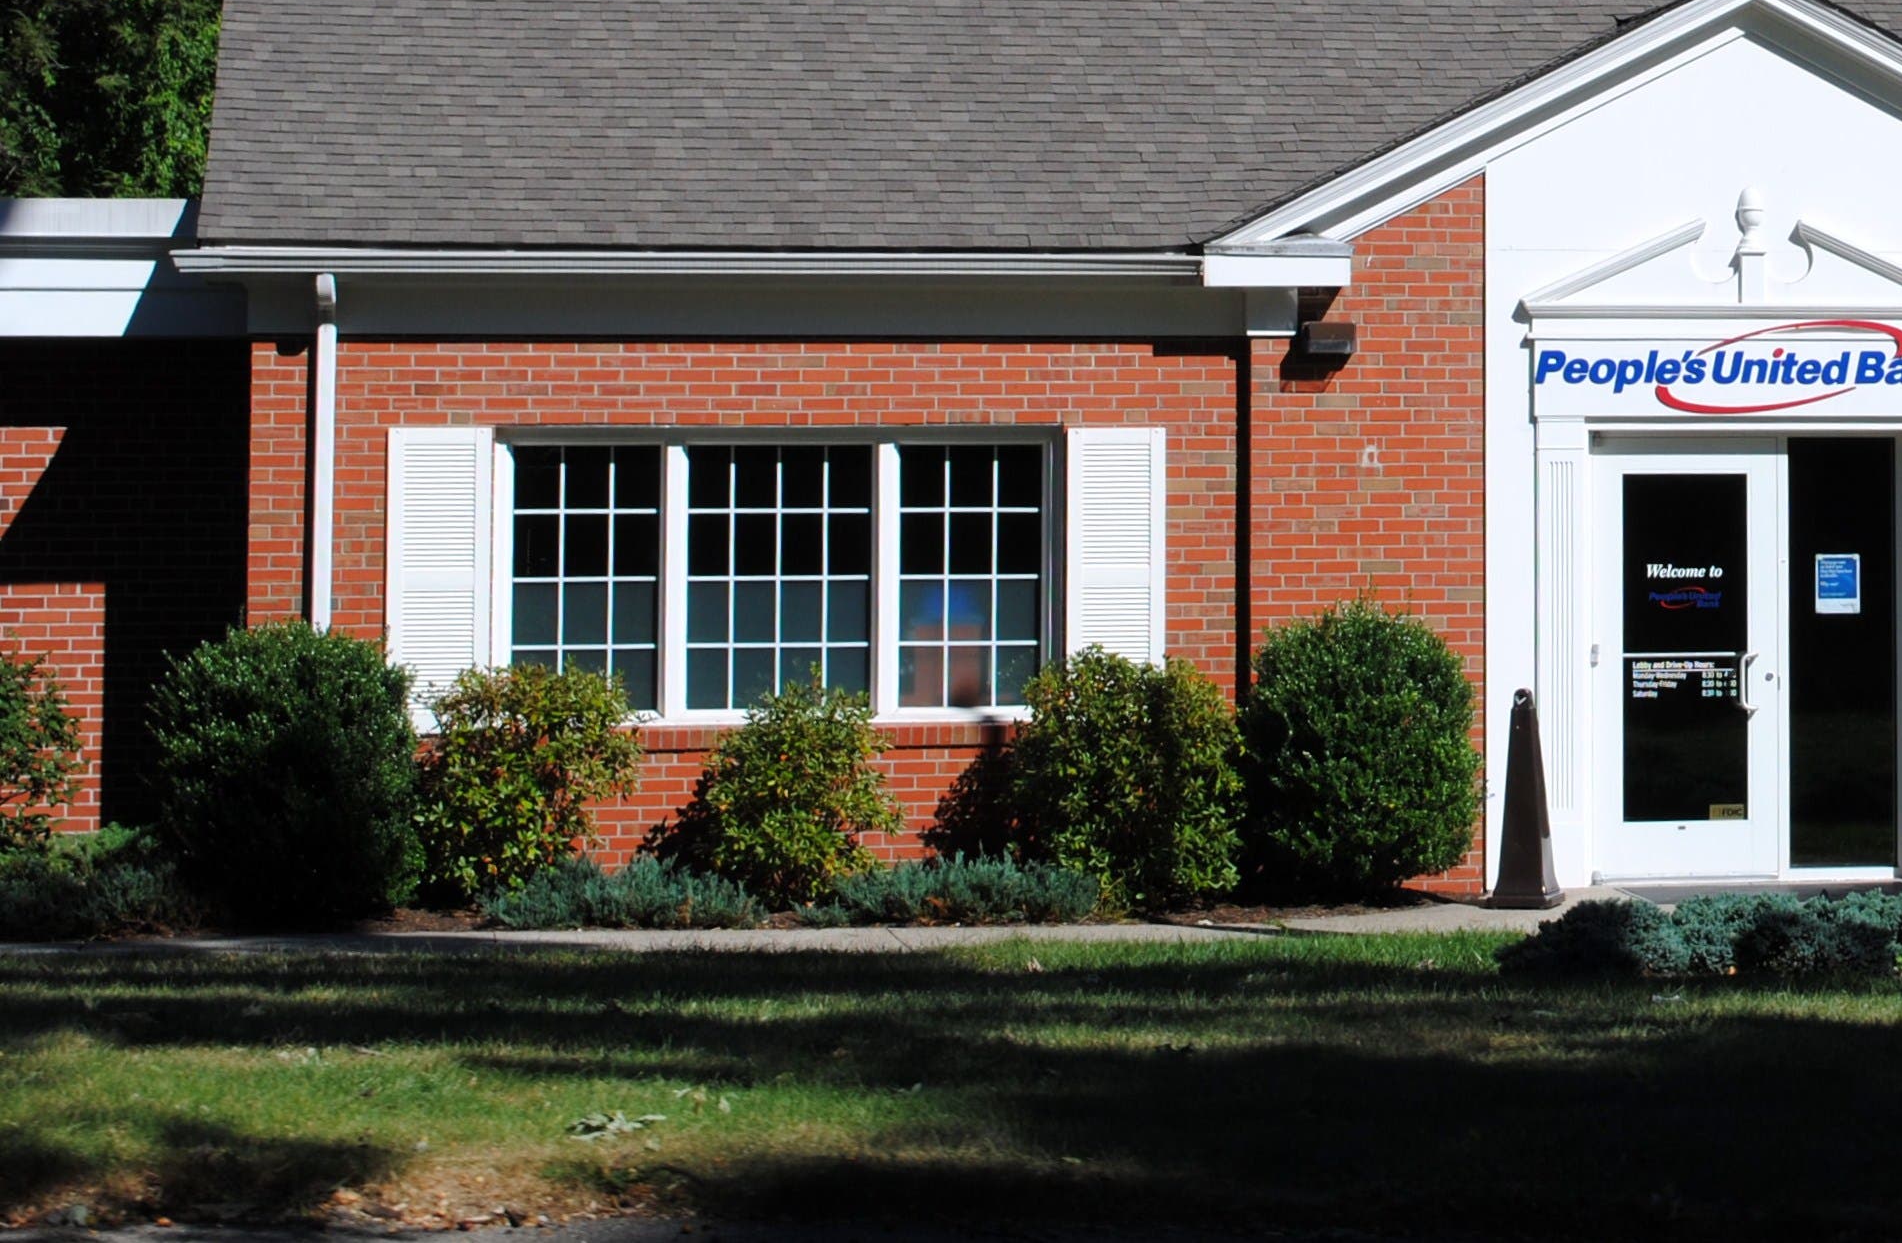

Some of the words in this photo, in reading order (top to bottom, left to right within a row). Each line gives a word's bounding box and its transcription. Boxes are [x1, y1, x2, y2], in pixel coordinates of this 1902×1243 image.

[1535, 350, 1706, 393] People's
[1711, 348, 1850, 385] United
[1646, 563, 1706, 578] Welcome
[1709, 565, 1723, 578] to
[1632, 661, 1651, 670] Lobby
[1653, 661, 1665, 669] and
[1632, 690, 1658, 699] Saturday
